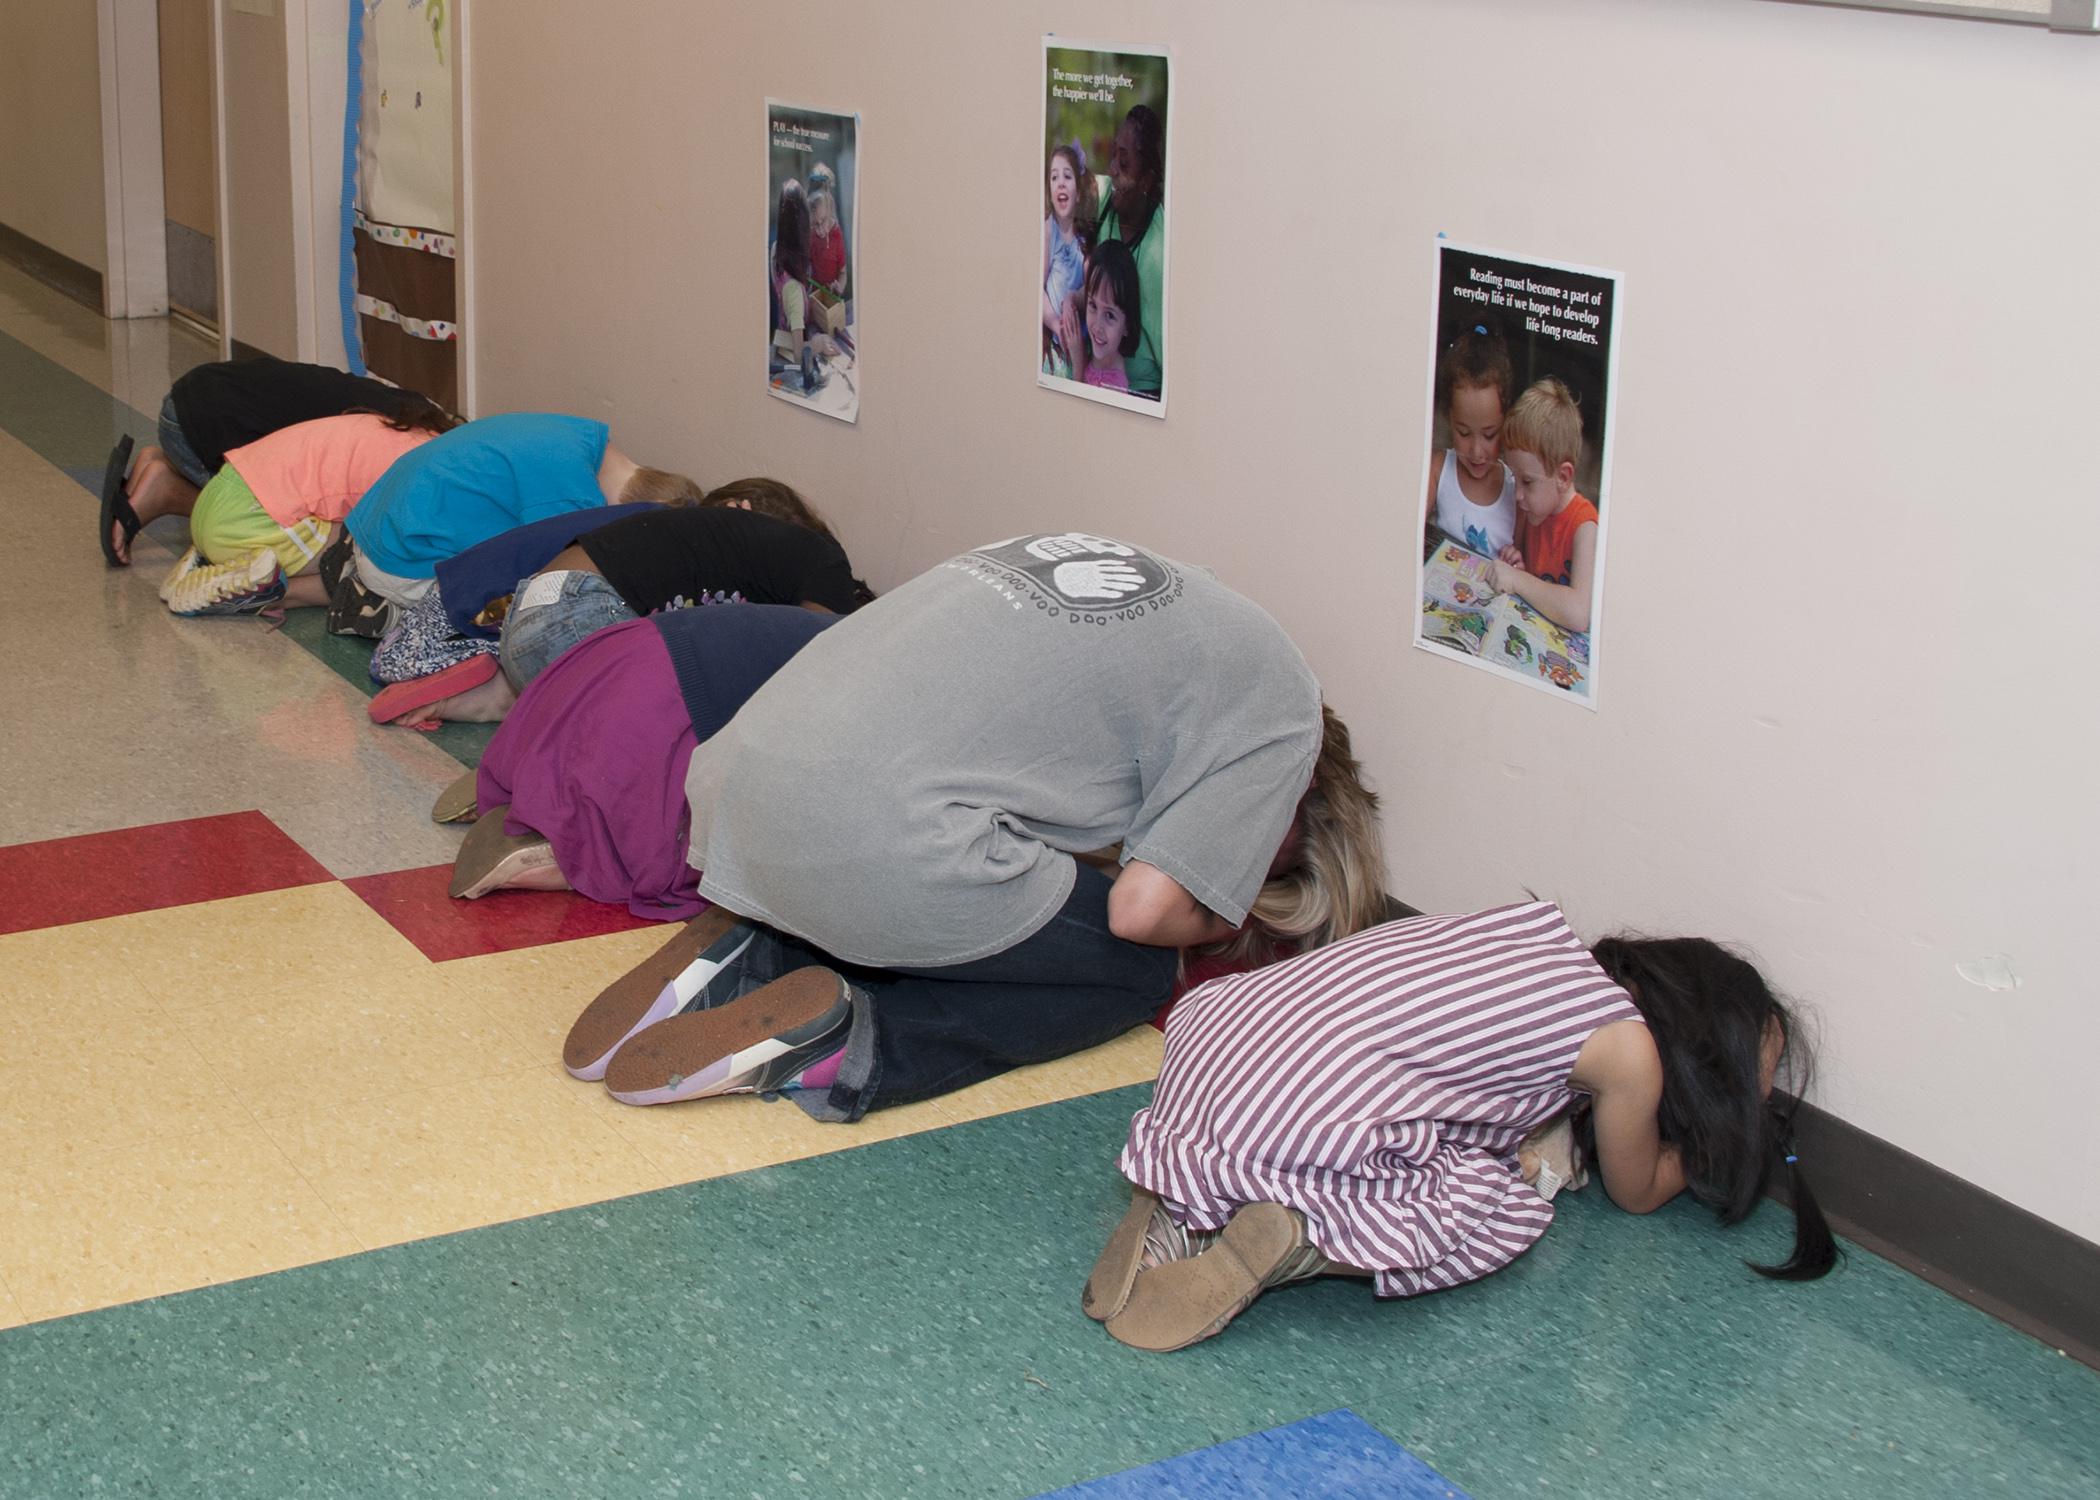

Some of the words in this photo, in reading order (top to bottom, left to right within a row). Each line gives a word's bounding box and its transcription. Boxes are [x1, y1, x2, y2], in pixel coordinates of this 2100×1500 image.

[1053, 69, 1064, 80] The
[1065, 73, 1082, 82] more
[1083, 75, 1093, 83] we
[1094, 75, 1104, 87] get
[1105, 74, 1133, 89] together,
[1053, 85, 1063, 97] the
[1064, 86, 1087, 102] happier
[1470, 267, 1503, 290] Reading
[1504, 277, 1525, 290] must
[1526, 278, 1561, 298] become
[1562, 289, 1568, 300] a
[1569, 291, 1590, 305] part
[1591, 292, 1603, 306] of
[1453, 286, 1490, 305] everyday
[1491, 290, 1505, 306] life
[1506, 293, 1514, 307] if
[1514, 299, 1528, 310] we
[1528, 298, 1551, 318] hope
[1552, 304, 1562, 318] to
[1563, 307, 1600, 329] develop
[1525, 317, 1540, 334] life
[1541, 320, 1561, 341] long
[1562, 328, 1599, 345] readers.
